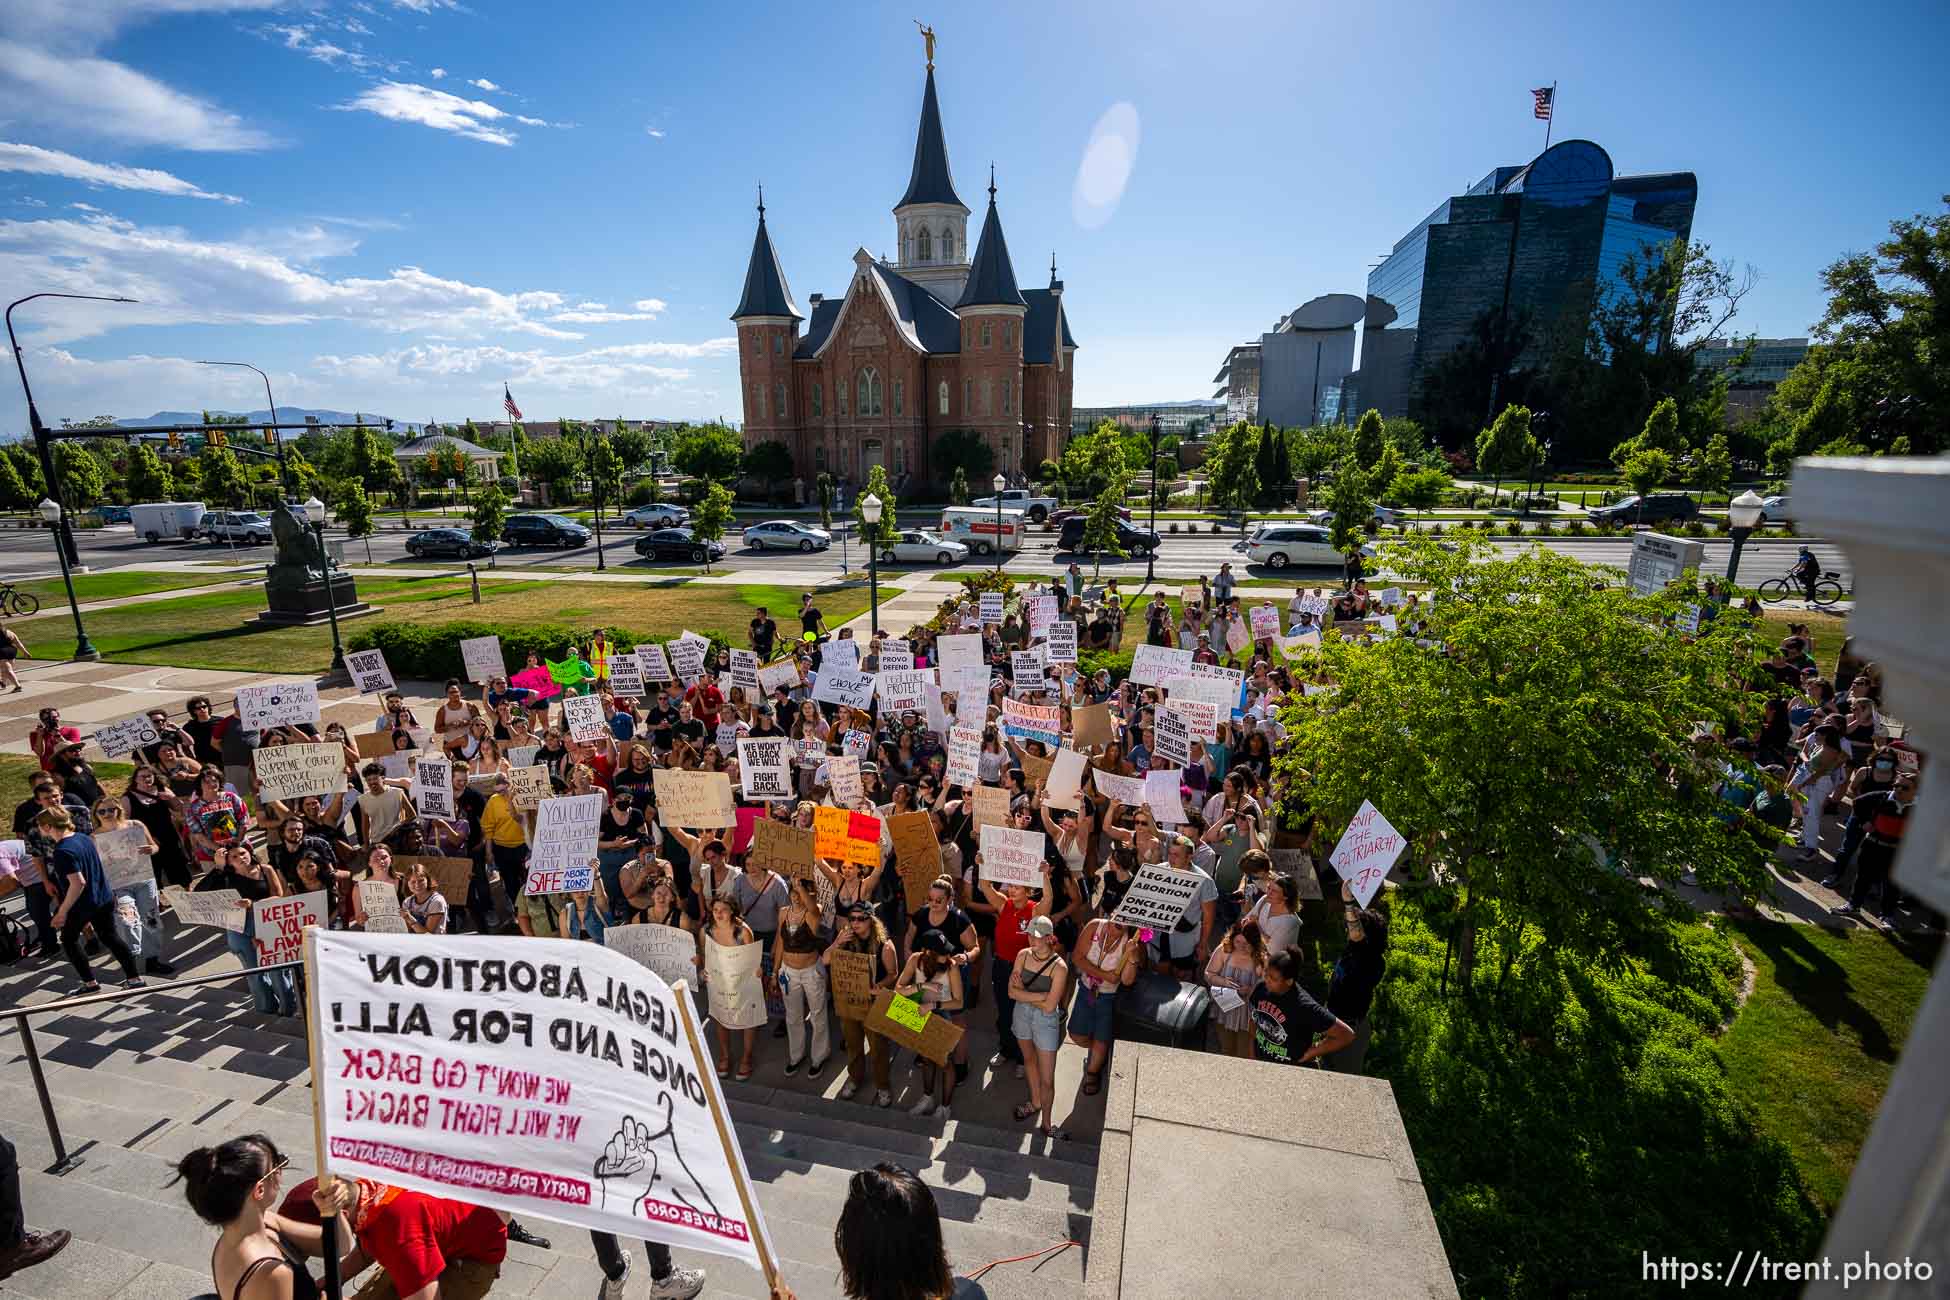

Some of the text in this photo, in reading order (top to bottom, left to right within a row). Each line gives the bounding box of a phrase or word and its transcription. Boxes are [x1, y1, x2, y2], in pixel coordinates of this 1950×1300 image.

[1191, 663, 1241, 679] GIVE US OUR
[886, 680, 923, 696] PROTECT
[568, 709, 579, 718] NO
[581, 714, 592, 723] MY
[1166, 710, 1179, 721] THE
[1156, 721, 1188, 739] IS SEXIST!
[1159, 715, 1186, 730] SYSTEM
[743, 742, 781, 751] WE WON'T
[1157, 734, 1187, 750] FIGHT FOR
[257, 746, 288, 763] ABORT
[746, 750, 780, 759] GO BACK
[1156, 742, 1188, 758] SOCIALISM!
[258, 755, 336, 777] SUPREME COURT
[428, 764, 447, 772] WON'T
[748, 757, 781, 767] WE WILL
[428, 771, 445, 779] BACK
[753, 772, 778, 782] FIGHT
[282, 777, 334, 797] DIGNITY
[421, 779, 445, 788] WE WILL
[512, 779, 529, 787] NOT
[753, 781, 780, 791] BACK!
[425, 792, 443, 802] FIGHT
[515, 796, 540, 806] LIFE
[425, 801, 445, 810] BACK!
[1349, 810, 1377, 832] SNIP
[1002, 831, 1023, 846] NO
[1347, 831, 1373, 845] THE
[1337, 834, 1399, 871] PATRIARCHY
[563, 868, 591, 879] ABORT
[1139, 869, 1200, 889] LEGALIZE
[528, 871, 564, 893] SAFE
[565, 879, 590, 889] IONS!
[1134, 882, 1192, 899] ABORTION
[261, 901, 306, 924] KEEP
[1126, 896, 1183, 914] ONCE AND
[1121, 905, 1176, 923] FOR ALL!
[277, 913, 317, 937] YOUR
[257, 934, 304, 956] LAW
[260, 948, 300, 967] OFF MY
